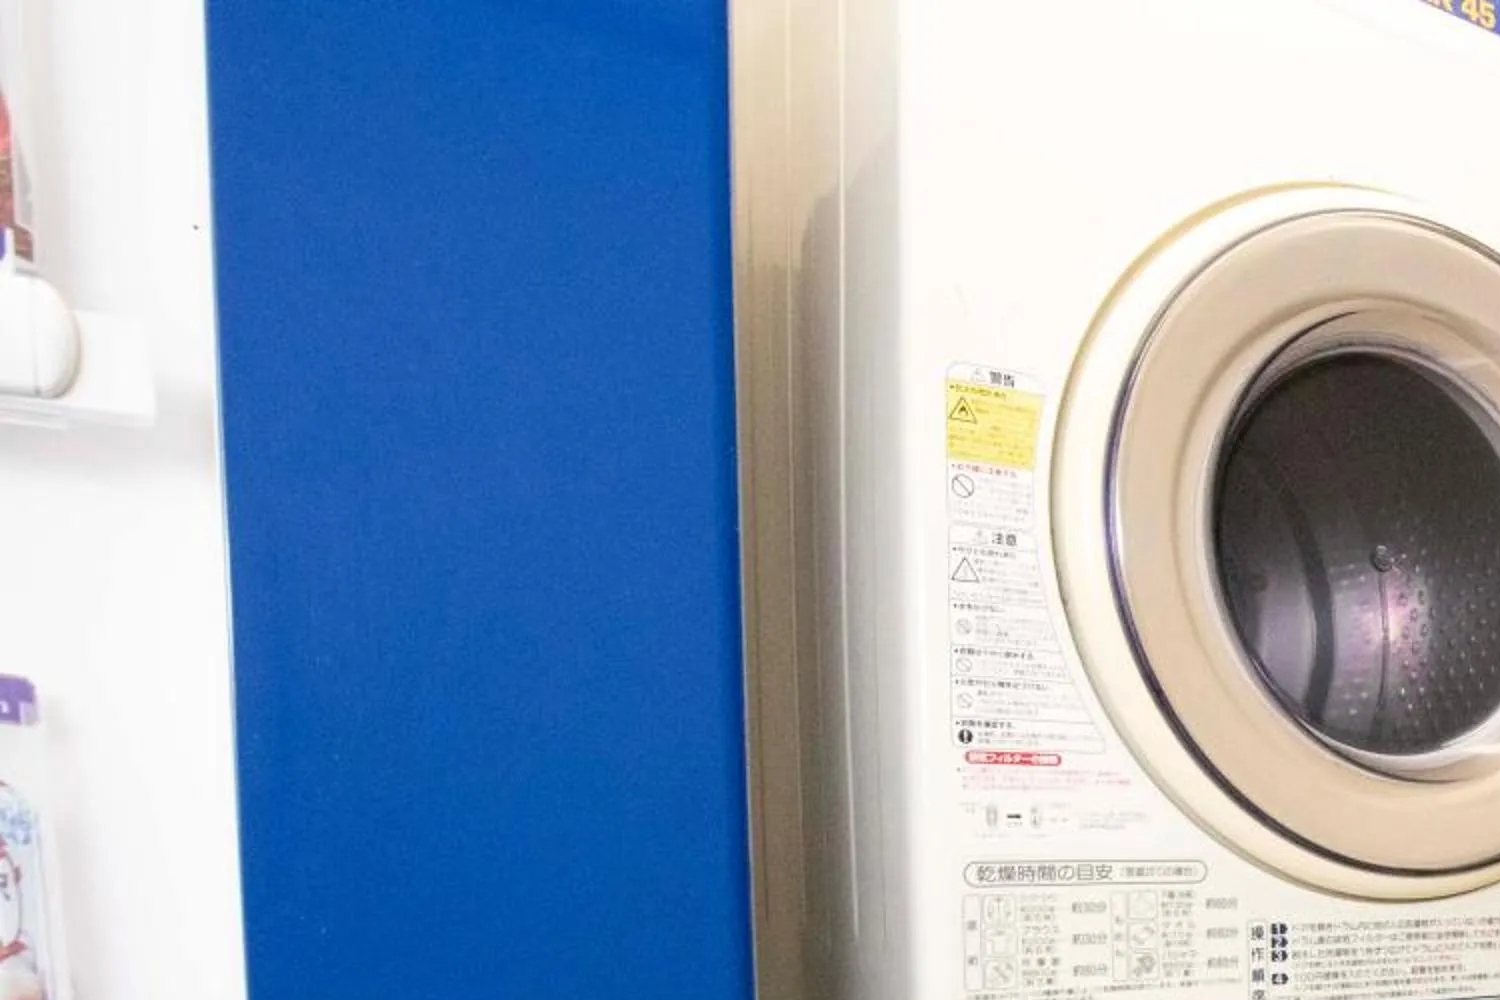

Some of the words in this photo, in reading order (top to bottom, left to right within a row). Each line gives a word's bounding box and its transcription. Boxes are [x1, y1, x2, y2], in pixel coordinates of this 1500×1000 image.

[976, 864, 1113, 882] 乾燥時間の目安
